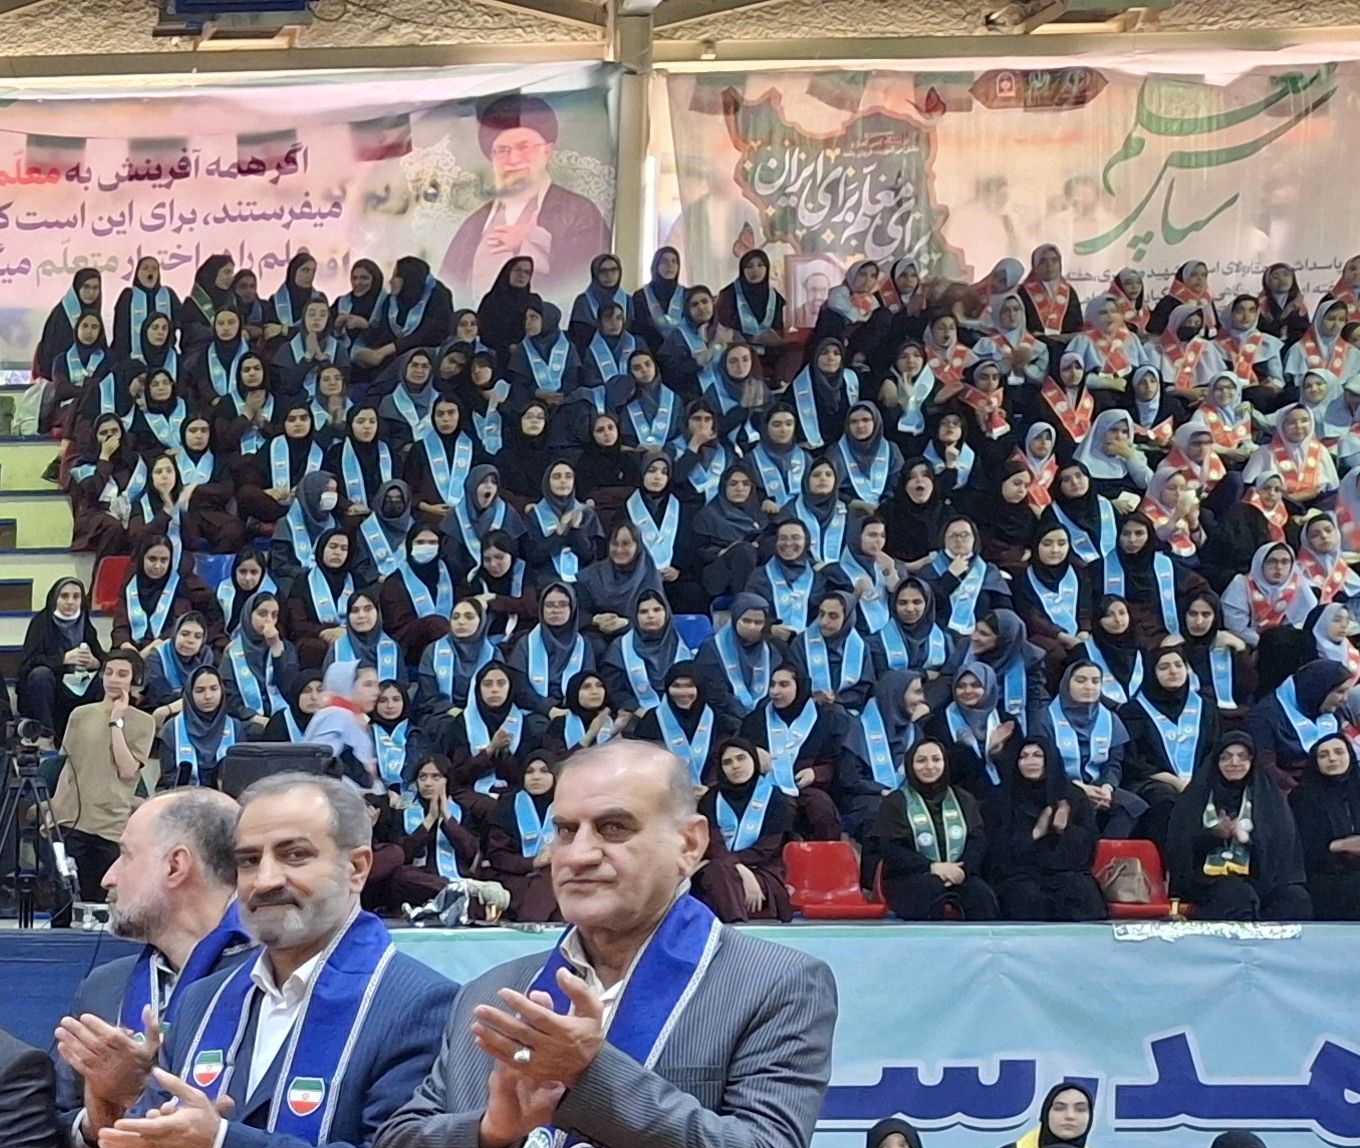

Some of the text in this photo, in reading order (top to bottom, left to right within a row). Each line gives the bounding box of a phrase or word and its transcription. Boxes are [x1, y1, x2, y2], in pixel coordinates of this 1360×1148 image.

[65, 162, 92, 191] به
[98, 147, 202, 191] آفرینش
[205, 156, 266, 179] همه
[269, 142, 308, 185] اگر
[15, 200, 86, 231] است
[91, 199, 134, 236] این
[139, 198, 198, 233] برای
[202, 191, 343, 230] میفرستند،
